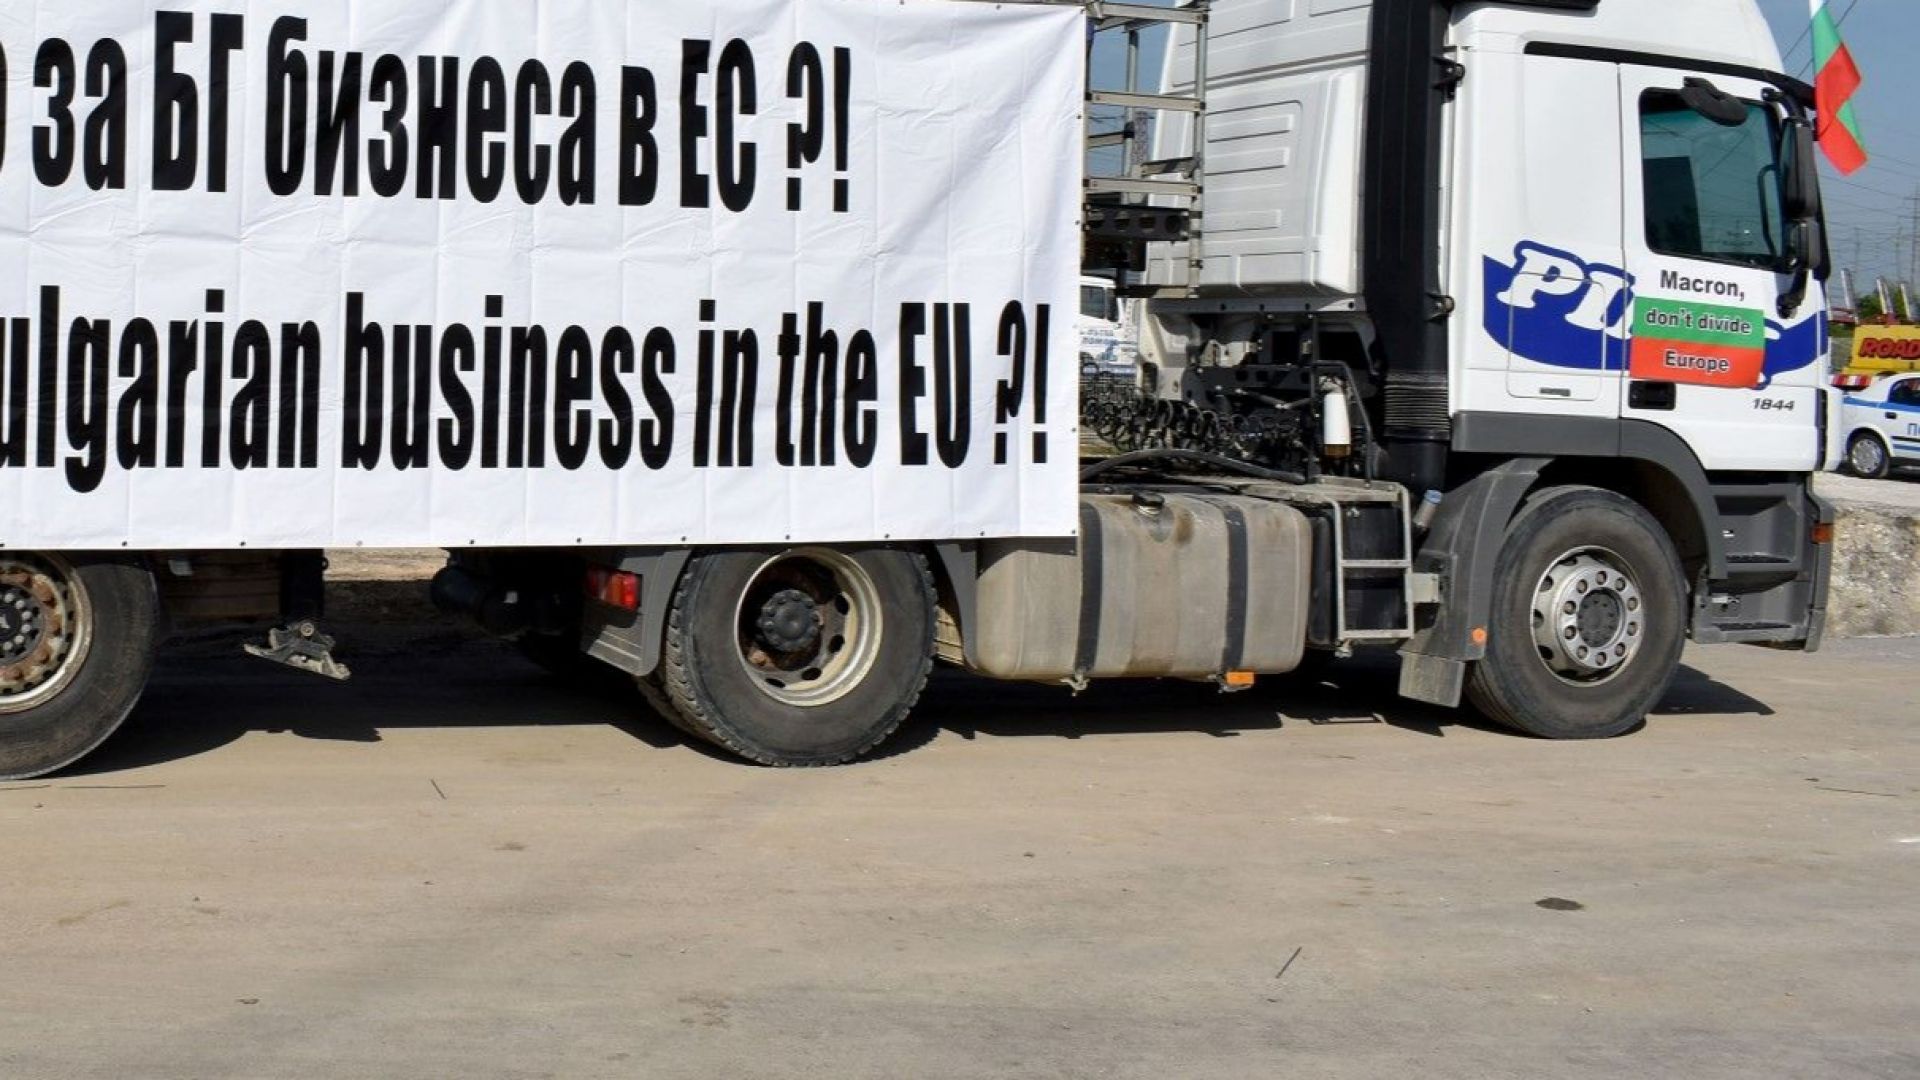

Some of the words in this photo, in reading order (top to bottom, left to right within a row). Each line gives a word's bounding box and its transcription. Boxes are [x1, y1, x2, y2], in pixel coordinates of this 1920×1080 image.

[33, 37, 127, 191] за
[152, 10, 244, 193] БГ
[264, 15, 597, 207] бизнеса
[618, 64, 659, 206] в
[680, 37, 757, 213] ЕС
[786, 40, 851, 213] ?!
[1660, 269, 1745, 301] Macron,
[1645, 307, 1694, 328] don't
[1697, 312, 1752, 334] divide
[1664, 349, 1730, 374] Europe
[341, 291, 677, 472] business
[693, 299, 759, 468] in
[775, 301, 878, 469] the
[899, 301, 972, 469] EU
[993, 299, 1050, 465] ?!
[1753, 398, 1796, 411] 1844
